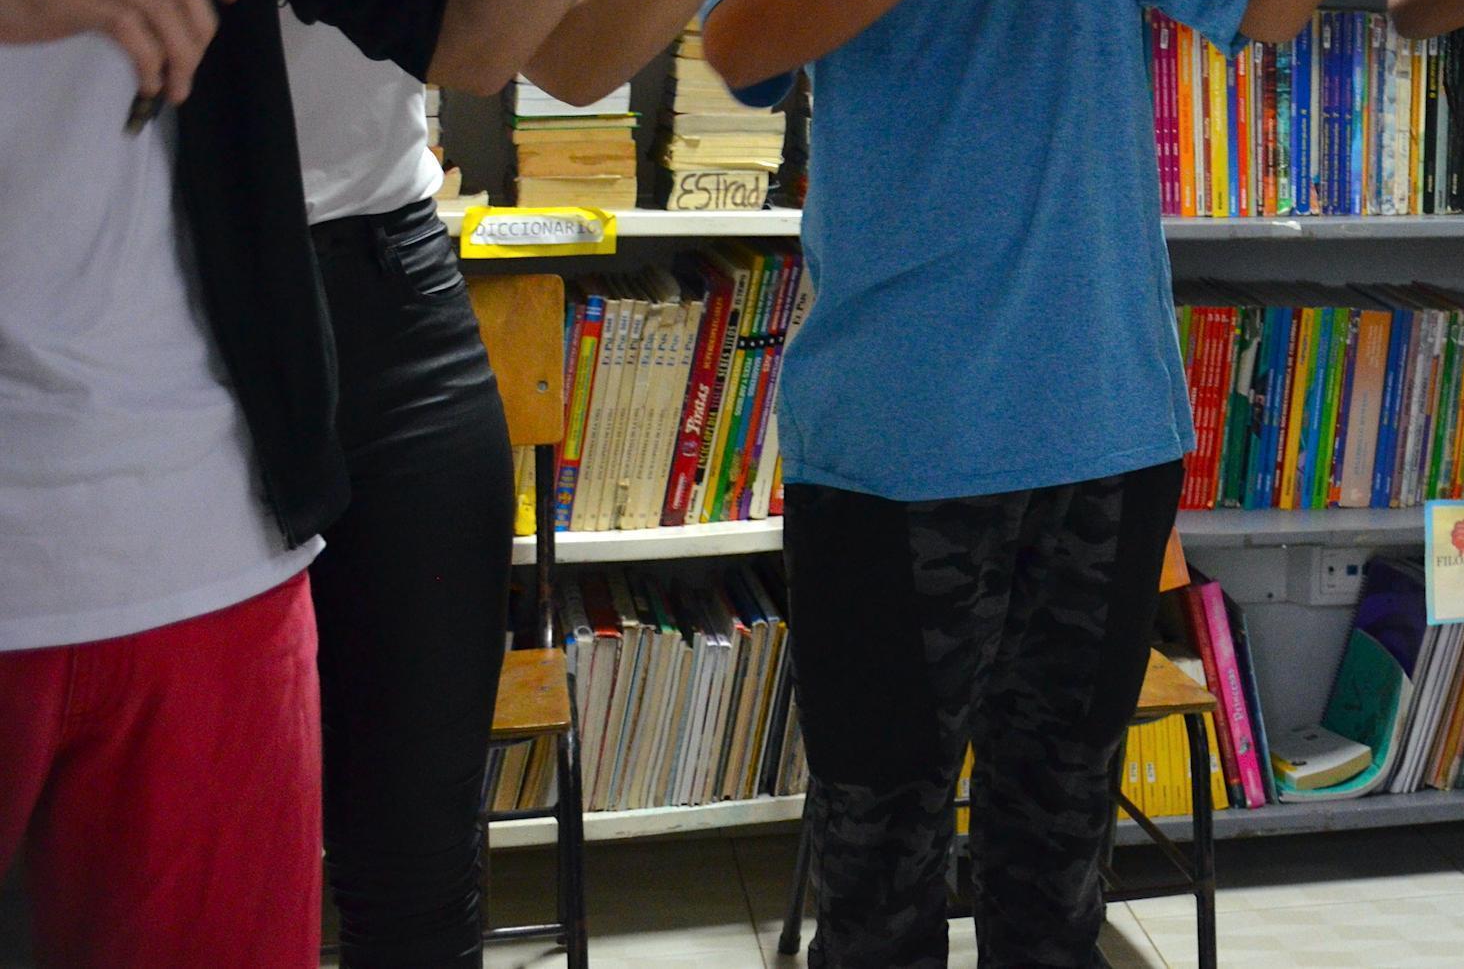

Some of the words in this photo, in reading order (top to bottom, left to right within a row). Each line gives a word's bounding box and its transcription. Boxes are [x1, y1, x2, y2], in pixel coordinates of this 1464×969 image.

[742, 356, 754, 377] PECES
[761, 353, 773, 373] AVES
[685, 383, 710, 435] Piratas
